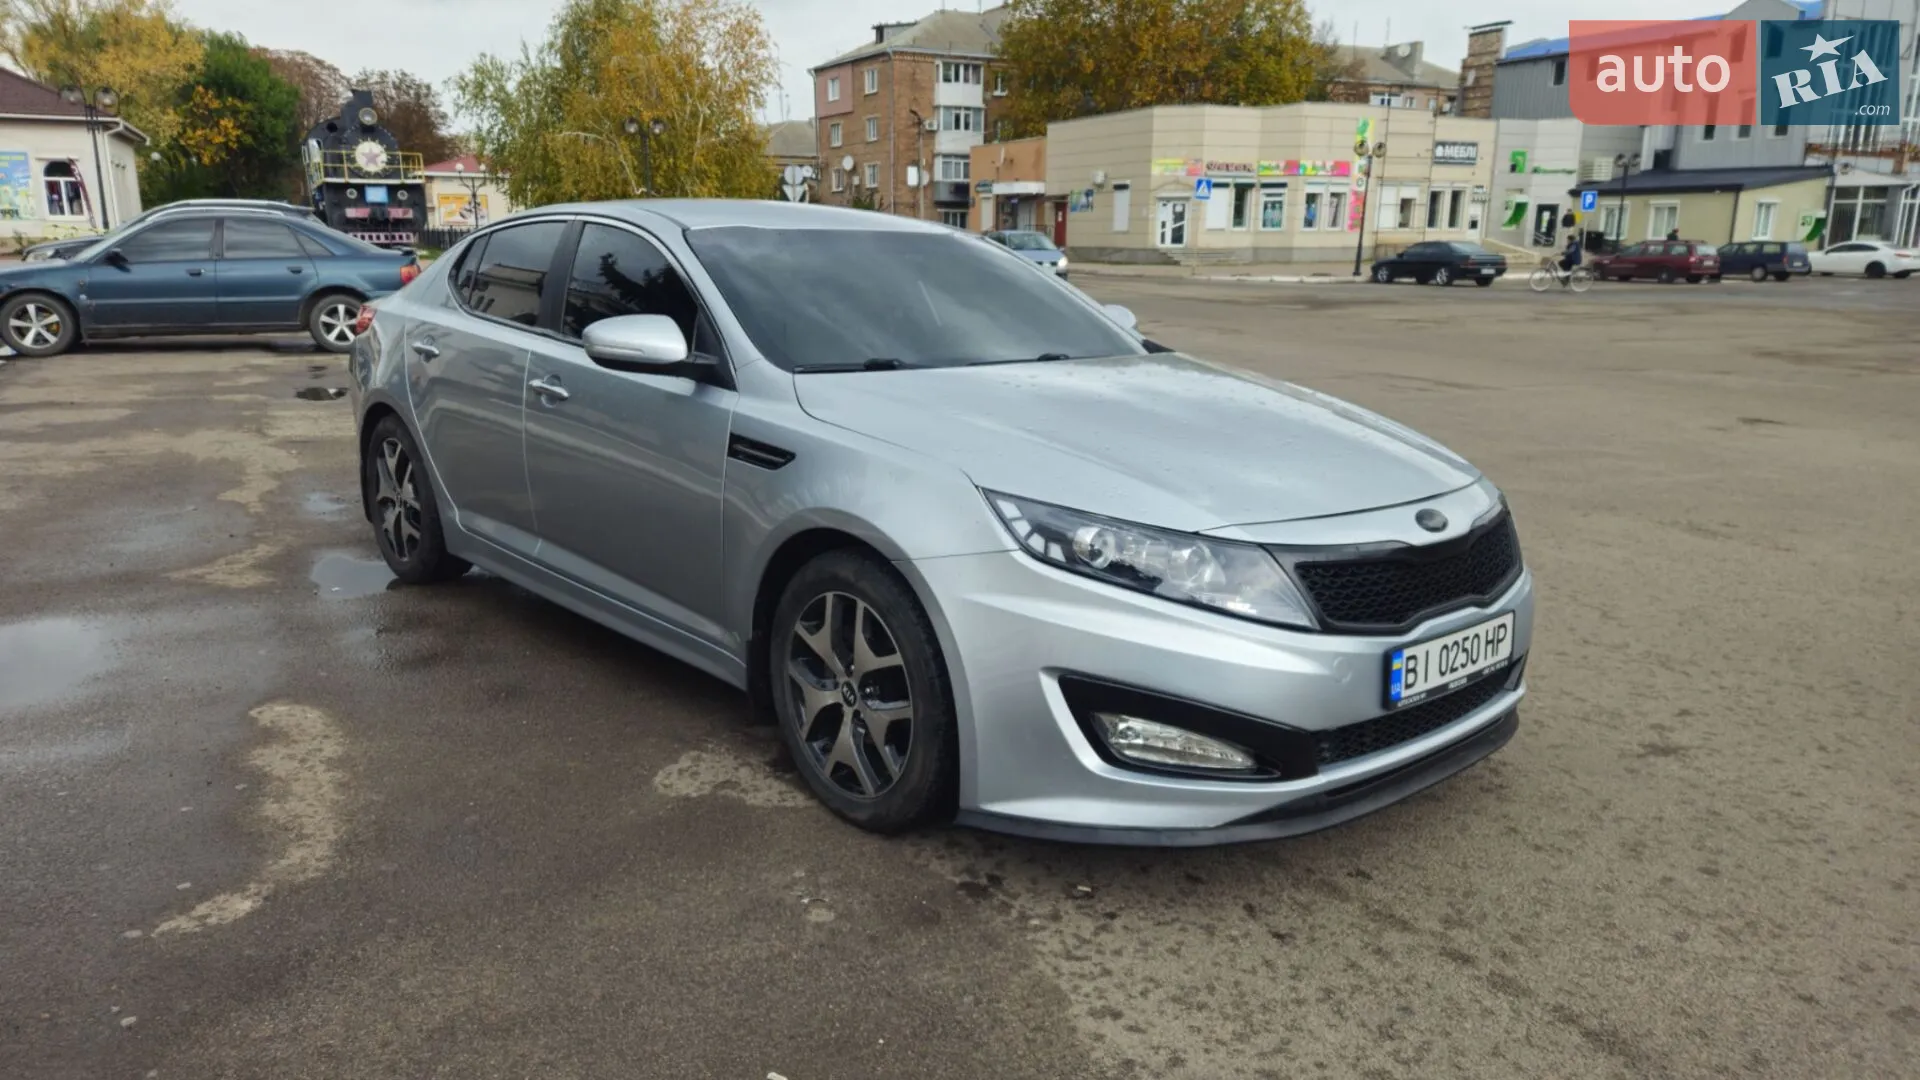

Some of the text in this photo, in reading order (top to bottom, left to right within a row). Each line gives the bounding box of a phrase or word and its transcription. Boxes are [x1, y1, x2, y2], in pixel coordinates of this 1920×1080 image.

[1404, 622, 1508, 691] BI 0250 HP
